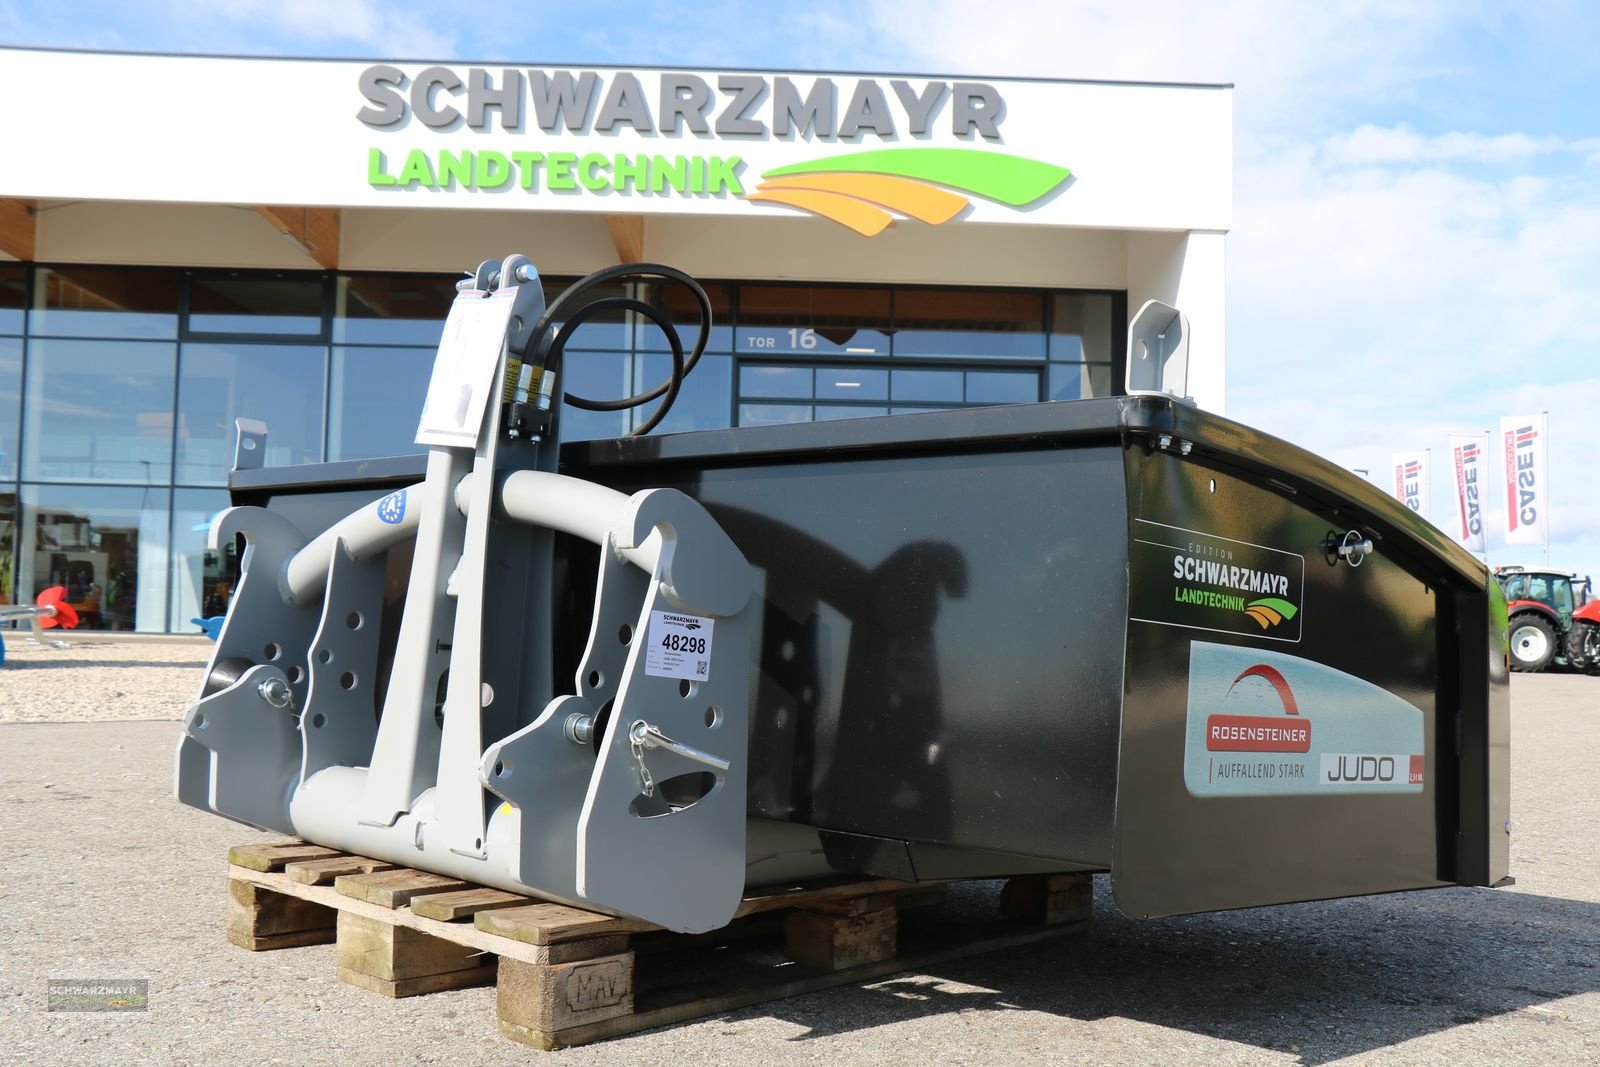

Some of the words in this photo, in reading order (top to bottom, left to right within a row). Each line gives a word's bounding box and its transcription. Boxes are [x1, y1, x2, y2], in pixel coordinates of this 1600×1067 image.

[356, 65, 1005, 140] SCHWARZMAYR
[368, 147, 745, 195] LANDTECHNIK
[747, 336, 776, 349] TOR
[788, 327, 817, 350] 16
[1188, 543, 1233, 560] EDITION
[1173, 555, 1289, 597] SCHWARZMAYR
[1175, 586, 1245, 612] LANDTECHNIK
[663, 614, 699, 624] SCHWARZMAYR
[662, 633, 706, 655] 48298
[1211, 726, 1307, 742] ROSENSTEINER
[1217, 763, 1276, 778] AUFFALLEND
[1279, 763, 1305, 778] STARK
[1328, 755, 1395, 782] JUDO
